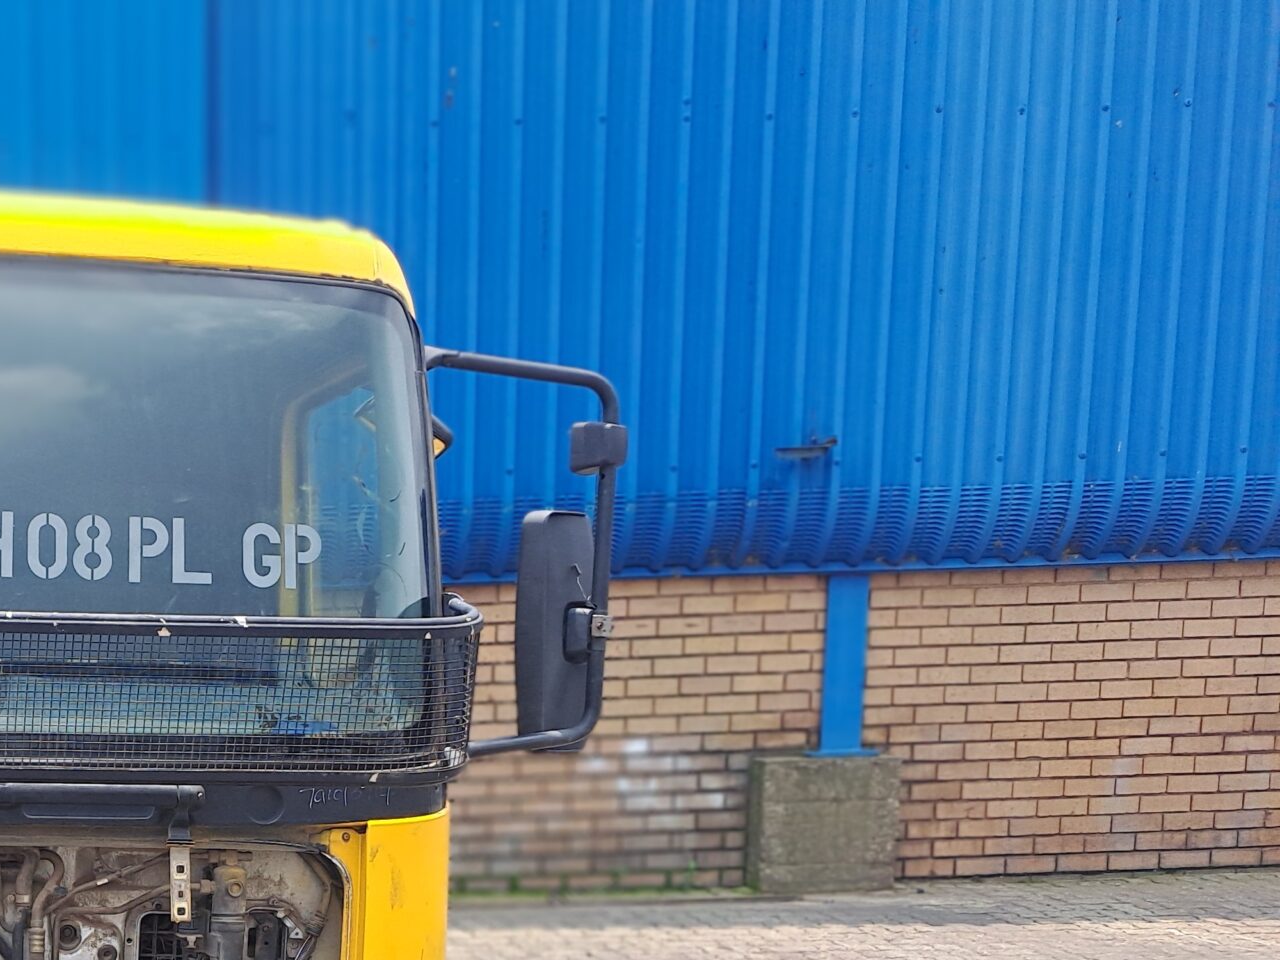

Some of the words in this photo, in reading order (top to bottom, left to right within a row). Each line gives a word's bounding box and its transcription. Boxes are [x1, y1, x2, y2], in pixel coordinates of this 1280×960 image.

[27, 513, 113, 581] 08
[128, 516, 213, 585] PL
[242, 522, 321, 590] GP
